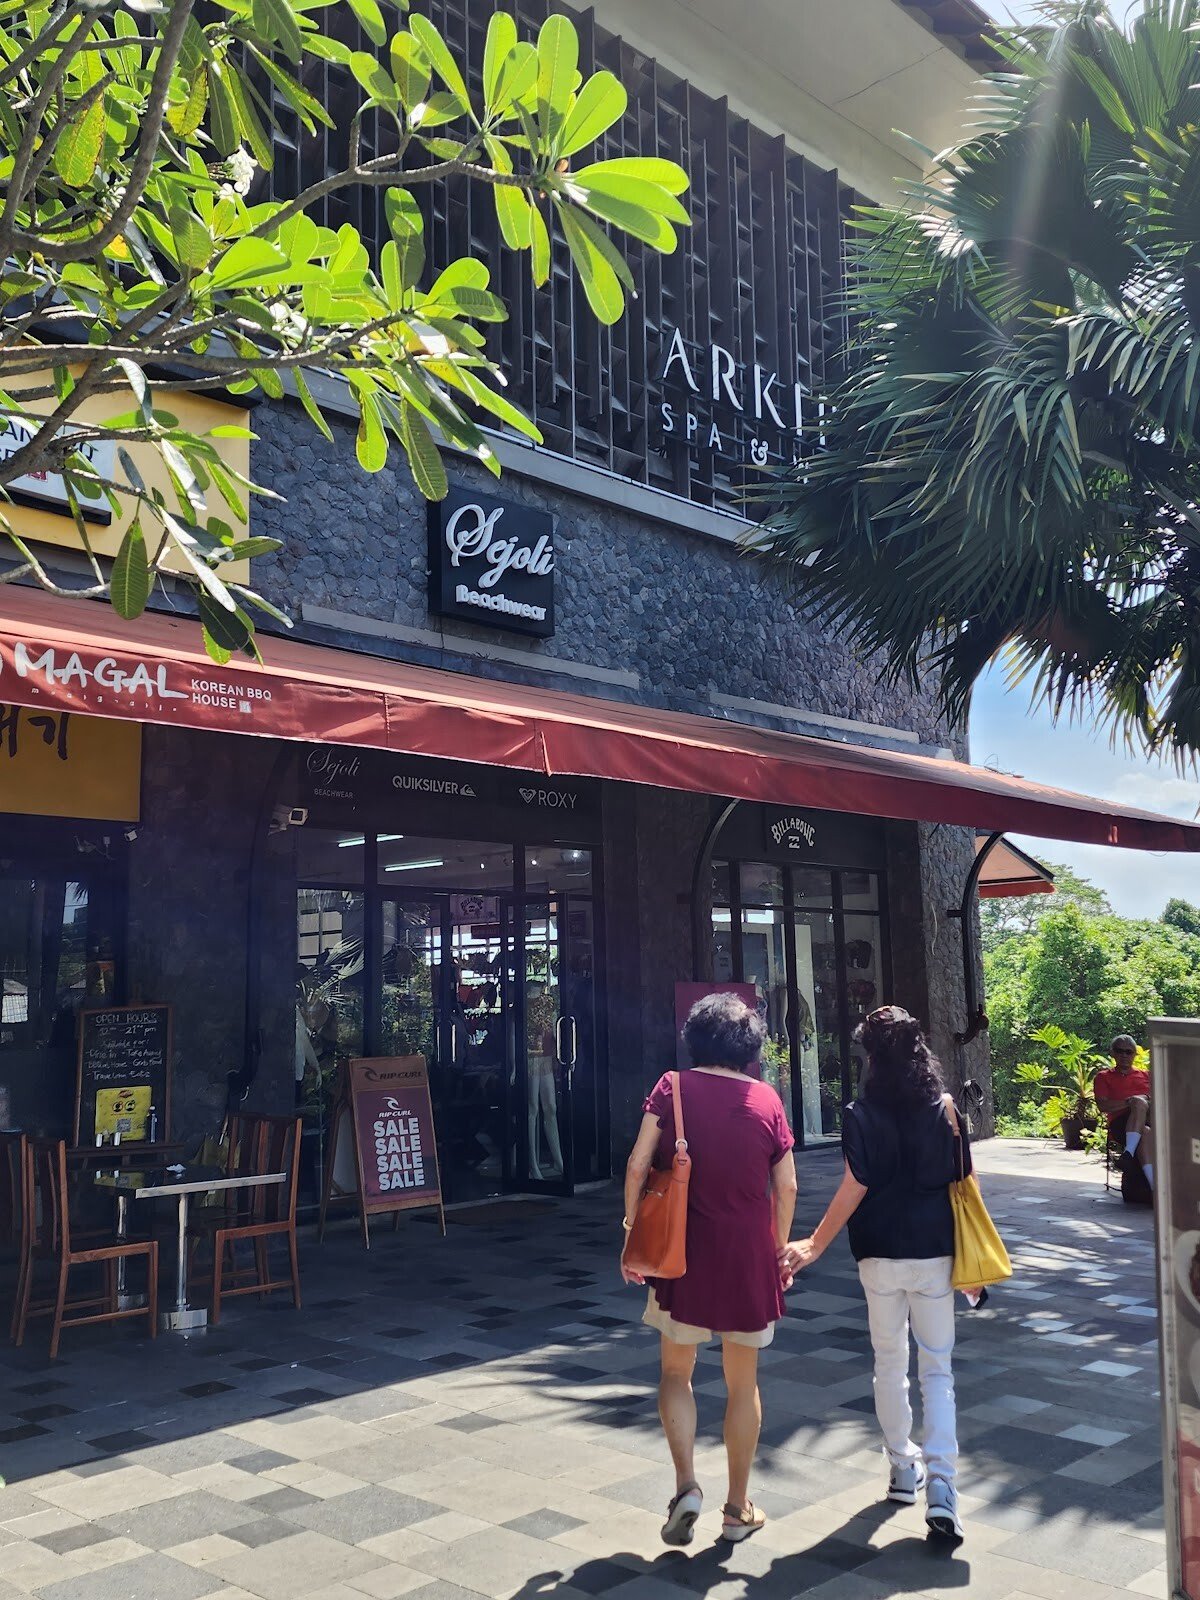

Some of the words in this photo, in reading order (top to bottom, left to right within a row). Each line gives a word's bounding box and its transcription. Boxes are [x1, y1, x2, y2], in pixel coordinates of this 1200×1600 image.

[663, 327, 838, 446] ARKI
[661, 402, 722, 451] SPA
[751, 438, 769, 466] &
[446, 504, 555, 588] Sejoli
[456, 584, 547, 621] Beachwear
[14, 642, 190, 698] MAGAL
[191, 679, 244, 697] KOREAN
[247, 687, 272, 702] BBQ
[192, 692, 237, 709] HOUSE
[306, 749, 360, 785] Sejoli
[313, 788, 354, 799] BEACHWEAR
[392, 775, 459, 795] QUIKSILVER
[538, 791, 577, 809] ROXY
[96, 1014, 120, 1024] OPEN
[126, 1012, 157, 1024] HOURS
[373, 1118, 420, 1138] SALE
[375, 1135, 421, 1155] SALE
[377, 1152, 423, 1173] SALE
[378, 1170, 425, 1191] SALE
